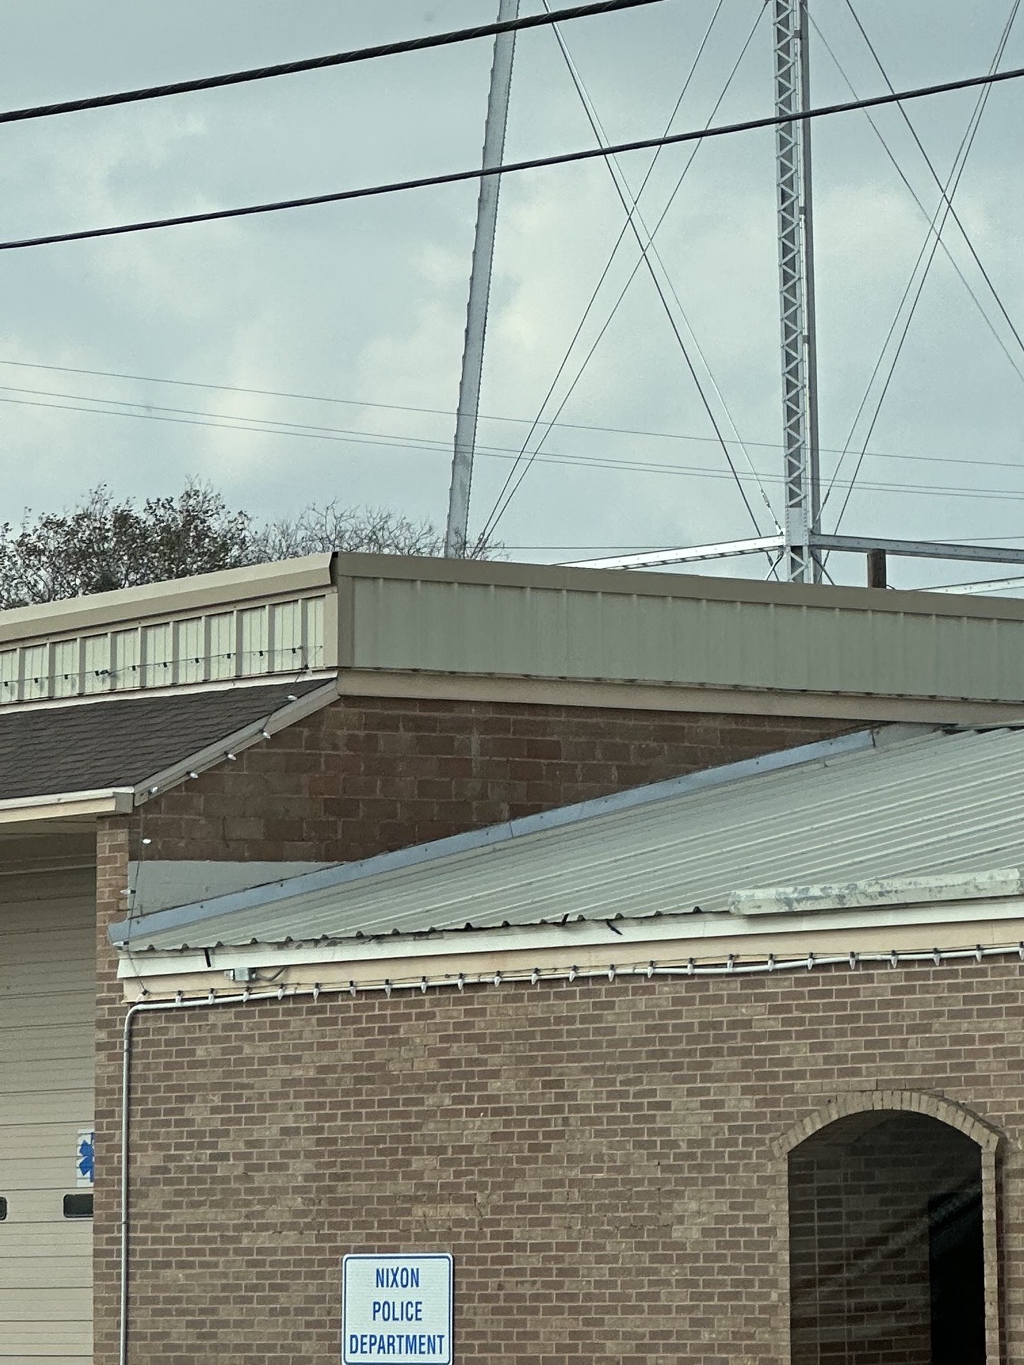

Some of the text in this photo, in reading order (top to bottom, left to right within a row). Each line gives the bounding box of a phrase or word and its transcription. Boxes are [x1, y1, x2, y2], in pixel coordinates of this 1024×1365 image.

[375, 1267, 420, 1288] NIXON
[372, 1300, 423, 1322] POLICE
[349, 1334, 445, 1355] DEPARTMENT
